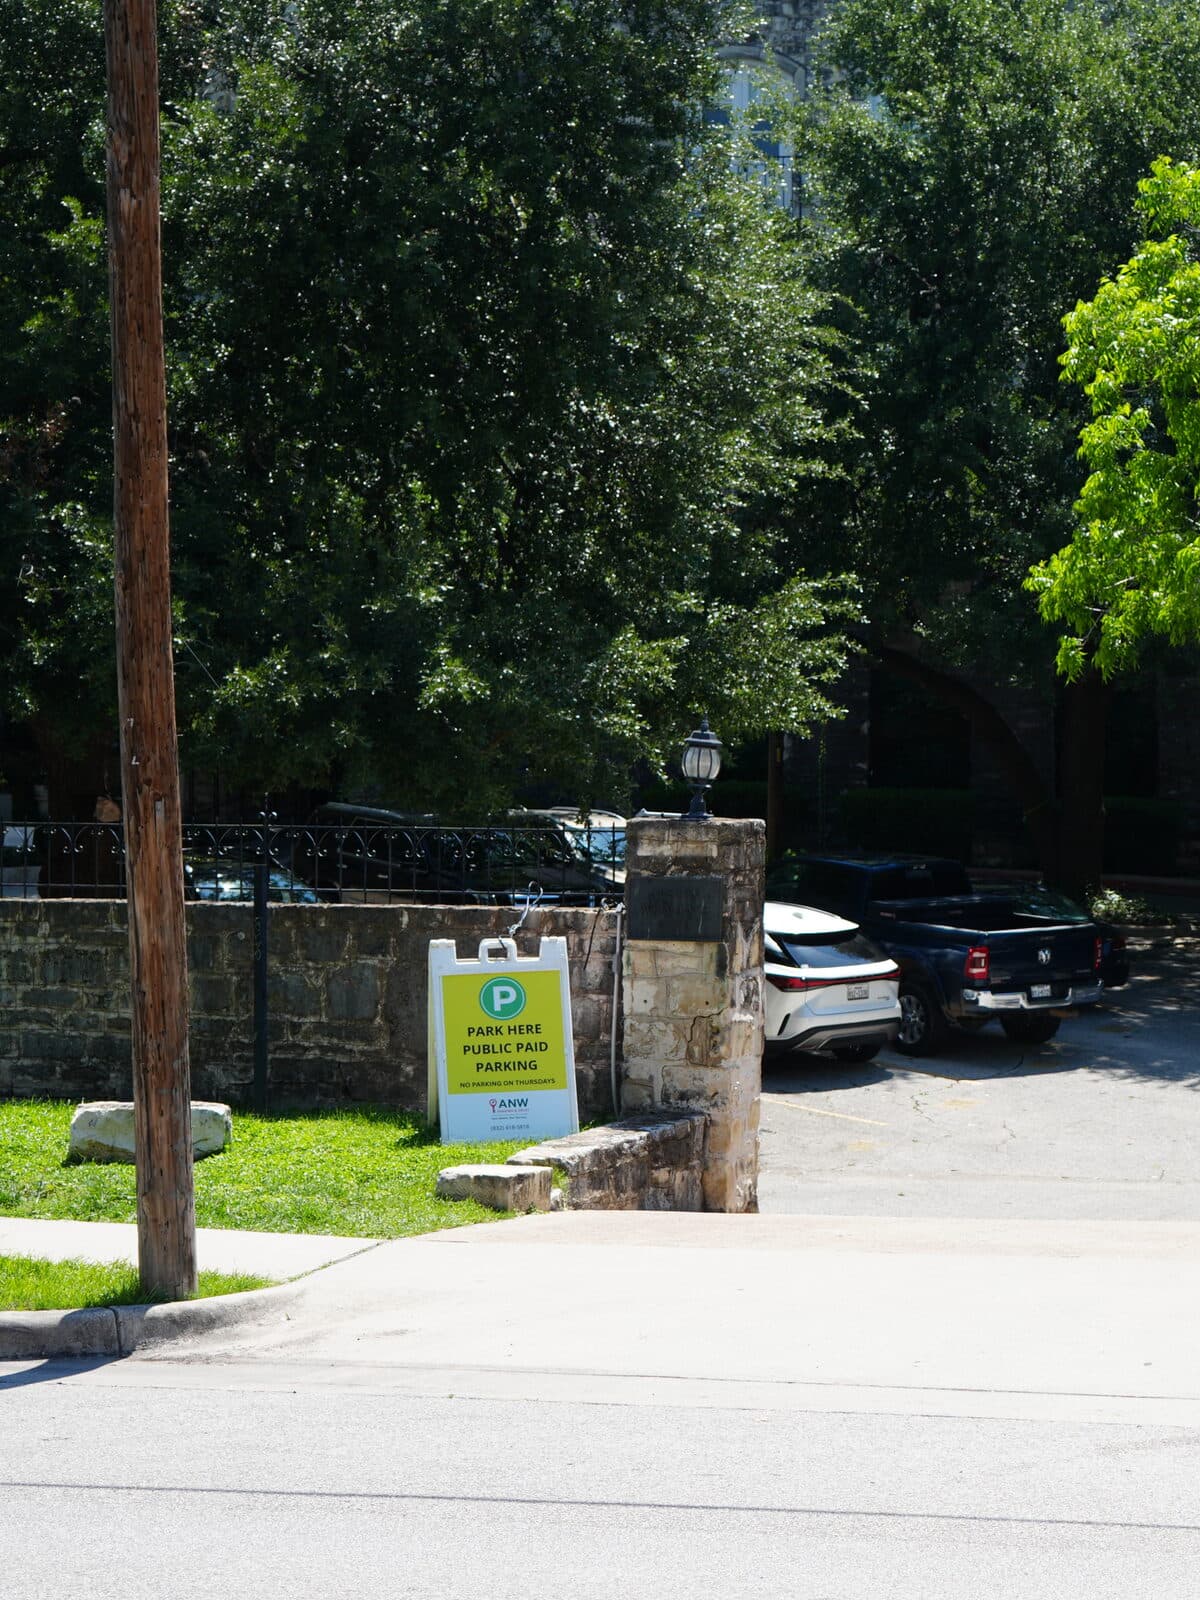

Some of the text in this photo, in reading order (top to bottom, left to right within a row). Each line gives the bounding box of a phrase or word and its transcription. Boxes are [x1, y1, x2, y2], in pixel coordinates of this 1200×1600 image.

[493, 985, 517, 1011] P
[467, 1023, 542, 1037] PARK HERE
[463, 1041, 548, 1055] PUBLIC PAID
[476, 1060, 538, 1073] PARKING
[459, 1081, 471, 1089] NO
[471, 1080, 502, 1088] PARKING
[515, 1078, 556, 1086] THURSDAYS
[498, 1098, 529, 1108] ANW
